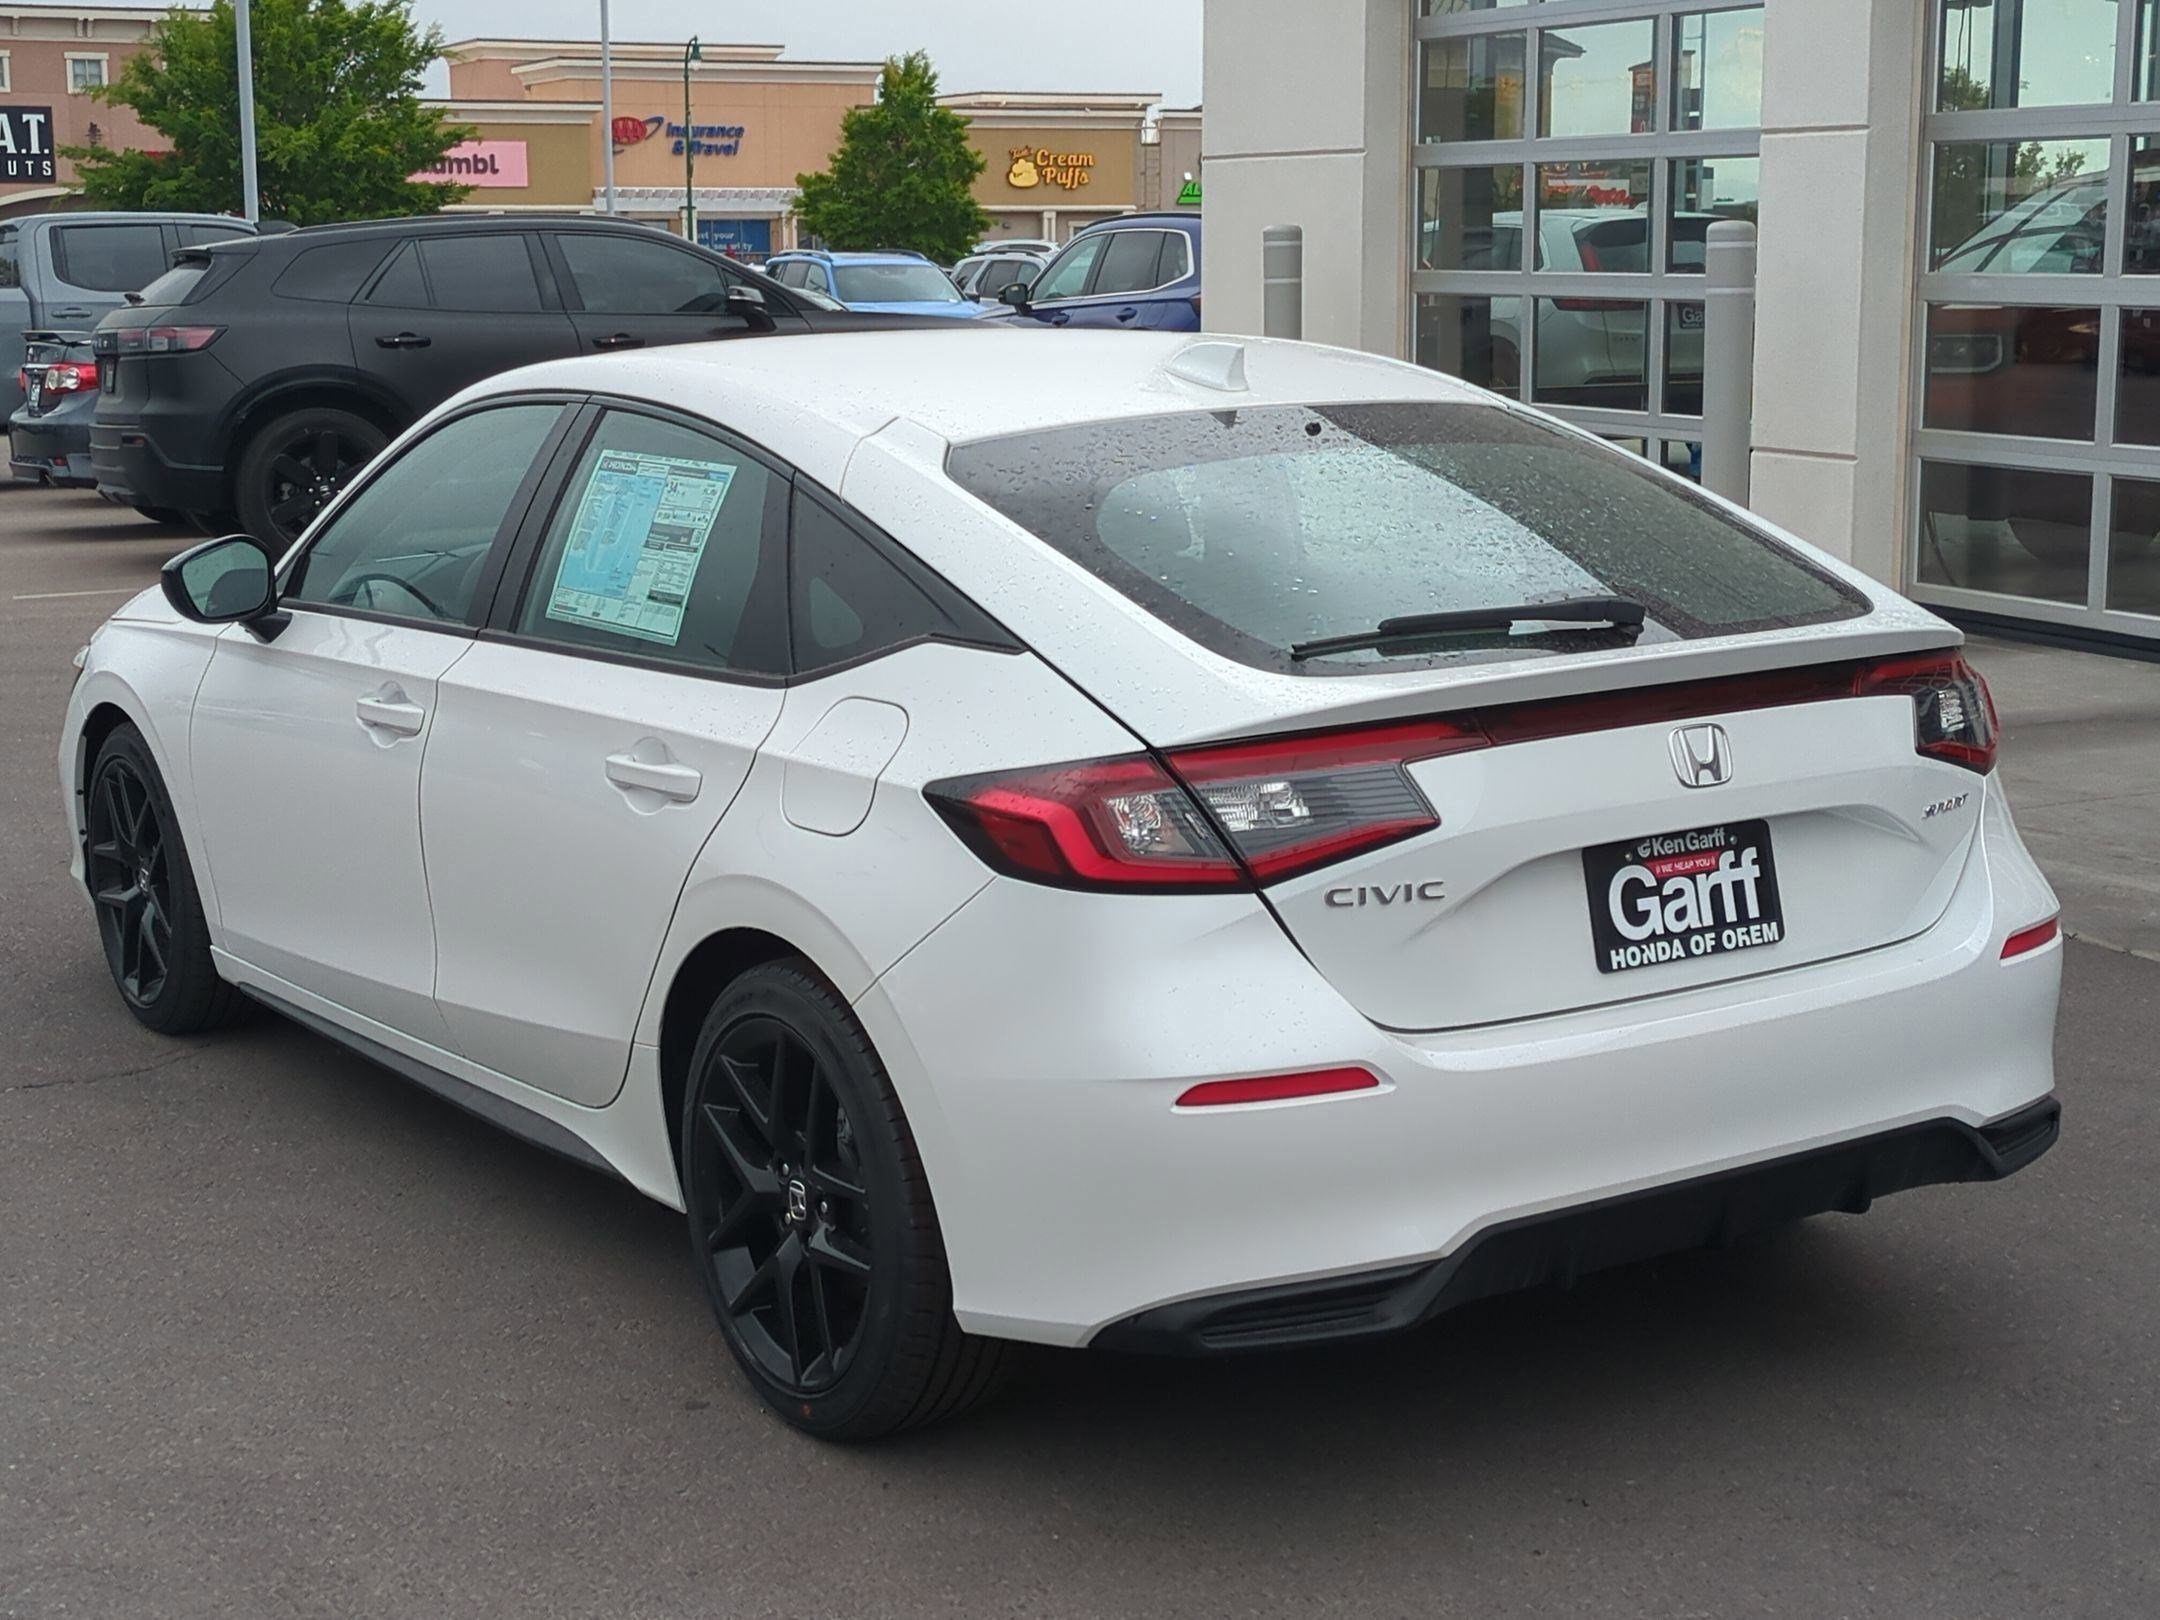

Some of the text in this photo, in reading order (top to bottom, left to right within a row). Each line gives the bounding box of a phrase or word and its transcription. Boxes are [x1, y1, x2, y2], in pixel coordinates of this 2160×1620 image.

[665, 122, 745, 139] Insurance
[672, 140, 684, 156] &
[1036, 148, 1095, 167] Cream
[7, 159, 52, 176] UTS
[431, 153, 500, 175] umbl
[1041, 166, 1090, 190] Puffs
[1651, 826, 1726, 857] Ken Garff
[1660, 863, 1673, 873] WE
[1695, 857, 1711, 868] YOU
[1323, 880, 1446, 908] CIVIC
[1608, 846, 1761, 942] Garff
[1610, 920, 1780, 971] HONDA OF OREM
